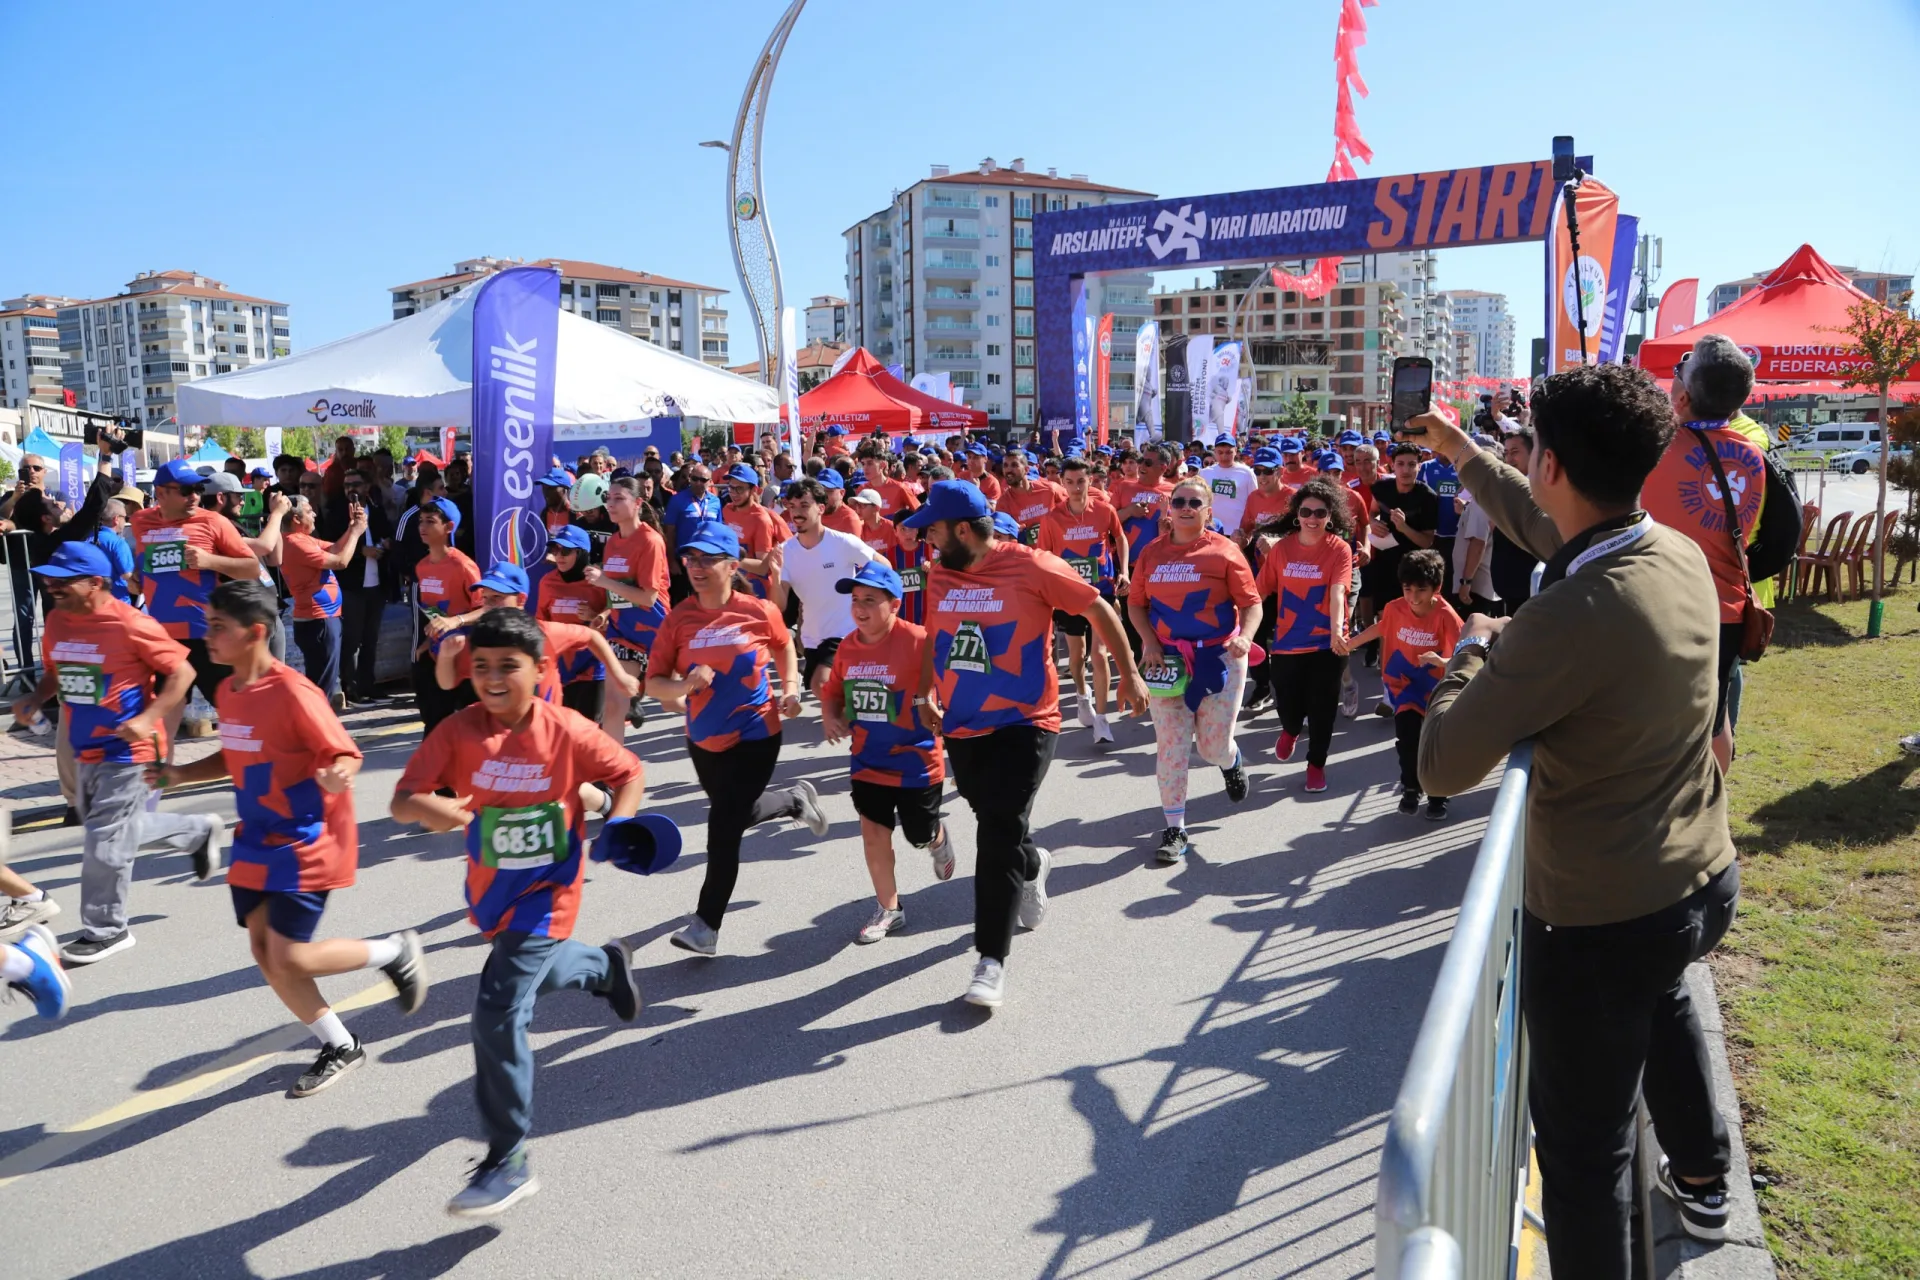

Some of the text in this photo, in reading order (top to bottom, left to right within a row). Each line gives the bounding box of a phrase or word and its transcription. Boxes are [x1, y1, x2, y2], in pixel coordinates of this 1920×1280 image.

[1108, 215, 1147, 228] MALATYA
[1210, 205, 1348, 241] YARI MARATONU
[1050, 225, 1146, 256] ARSLANTEPE
[331, 398, 377, 419] esenlik
[490, 331, 537, 500] esenlik
[63, 457, 79, 498] esenlik
[1214, 484, 1233, 494] 6786
[1440, 485, 1457, 494] 6315
[1678, 481, 1705, 515] YARI
[152, 549, 182, 566] 5666
[1154, 563, 1196, 574] ARSLANTEPE
[945, 588, 995, 600] ARSLANTEPE
[954, 600, 1004, 612] MARATONU
[846, 665, 889, 675] ARSLANTEPE
[1145, 667, 1178, 682] 6305
[852, 690, 888, 711] 5757
[492, 820, 555, 854] 6831
